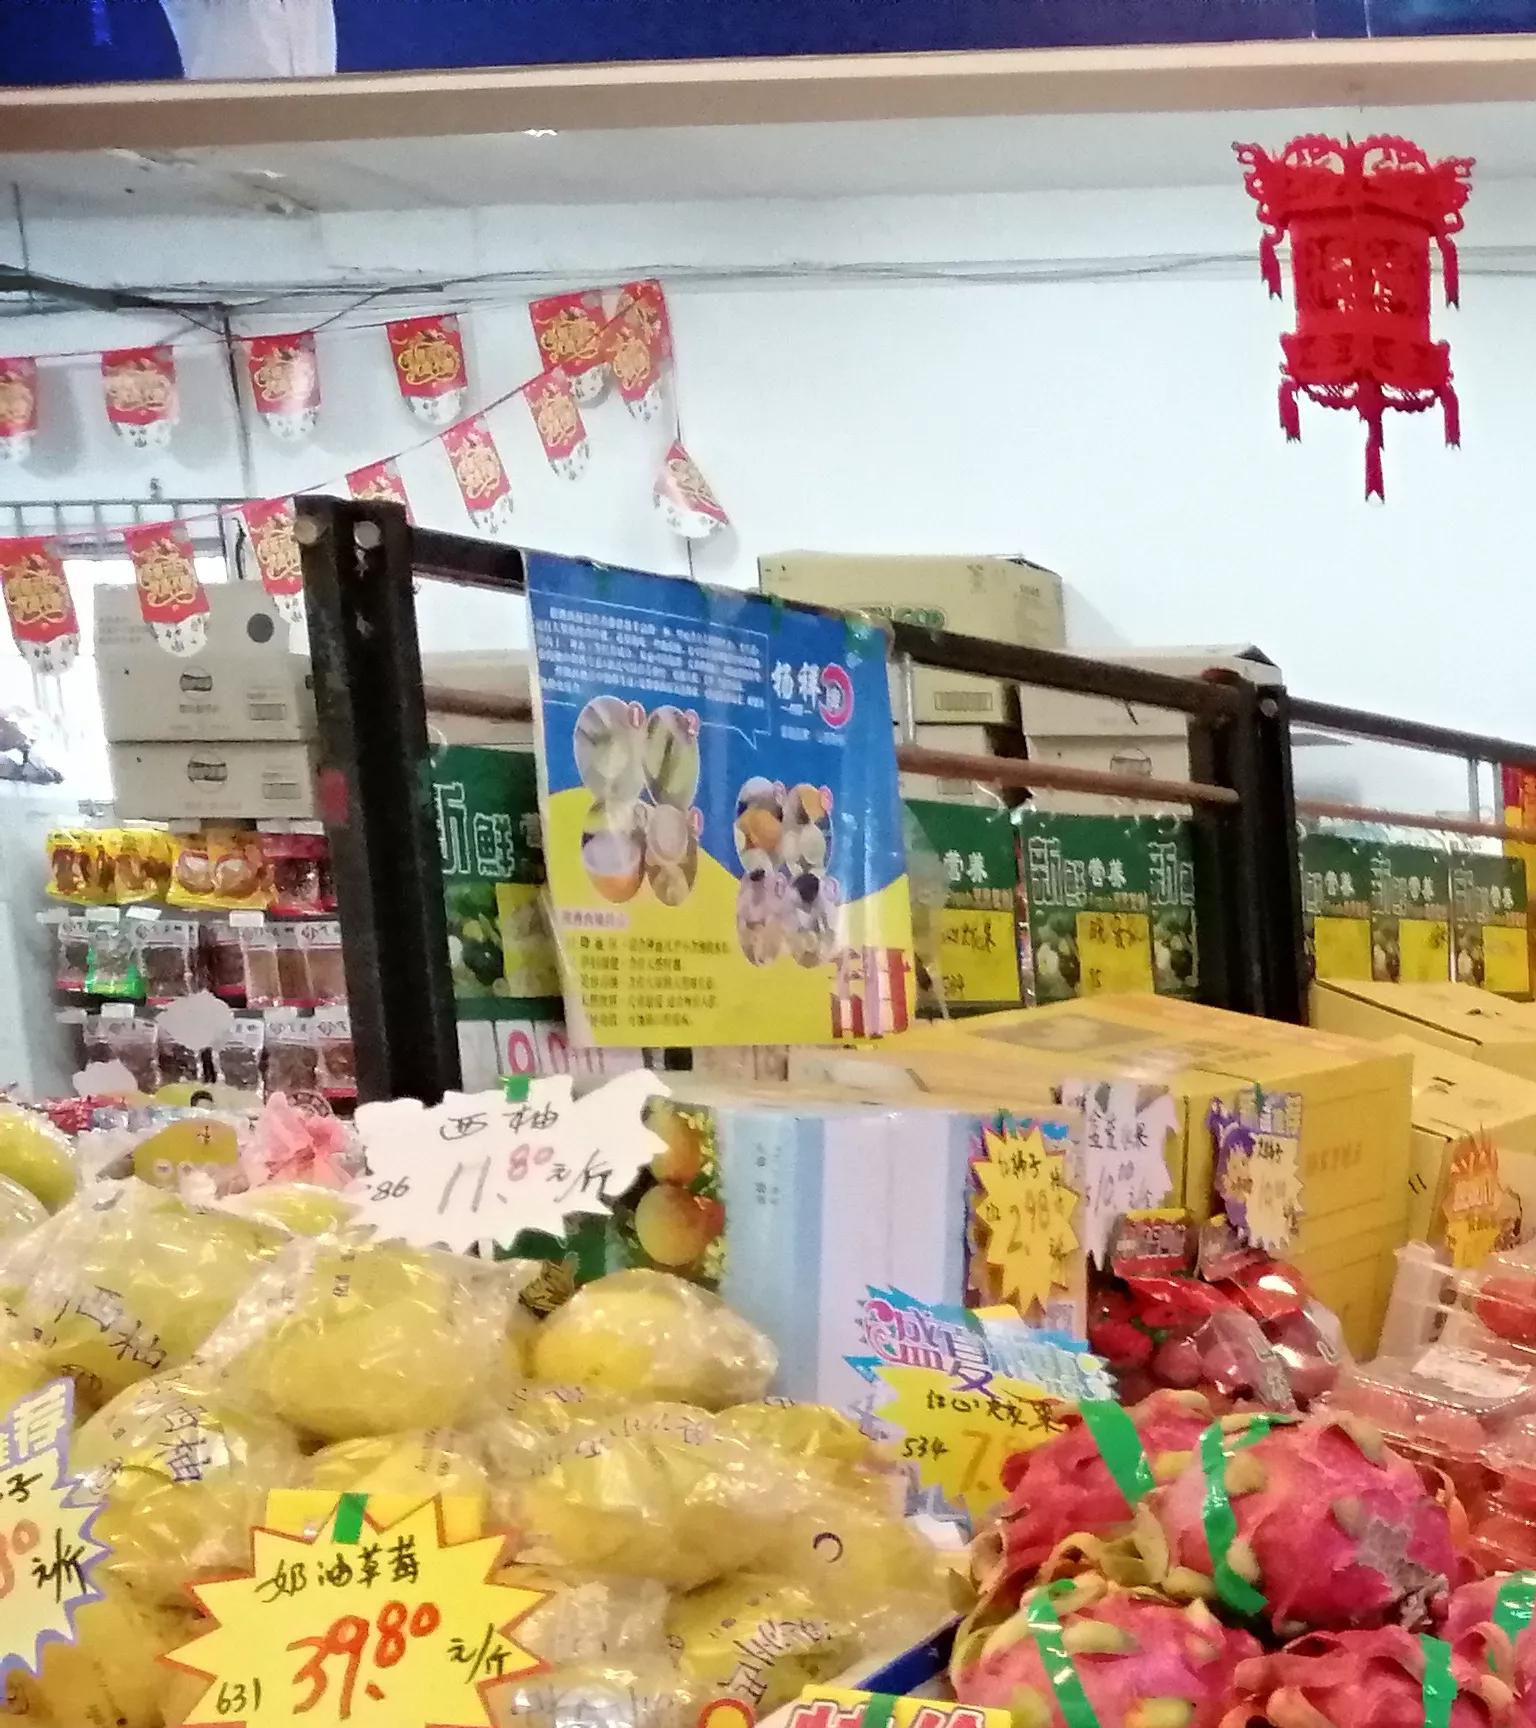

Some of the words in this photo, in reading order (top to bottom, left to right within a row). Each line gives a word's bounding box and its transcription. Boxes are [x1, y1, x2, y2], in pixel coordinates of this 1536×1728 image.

[254, 1534, 420, 1604] 奶油草莓
[286, 1602, 441, 1721] 39.80
[446, 1622, 510, 1682] 元/斤
[216, 1676, 262, 1716] 631
